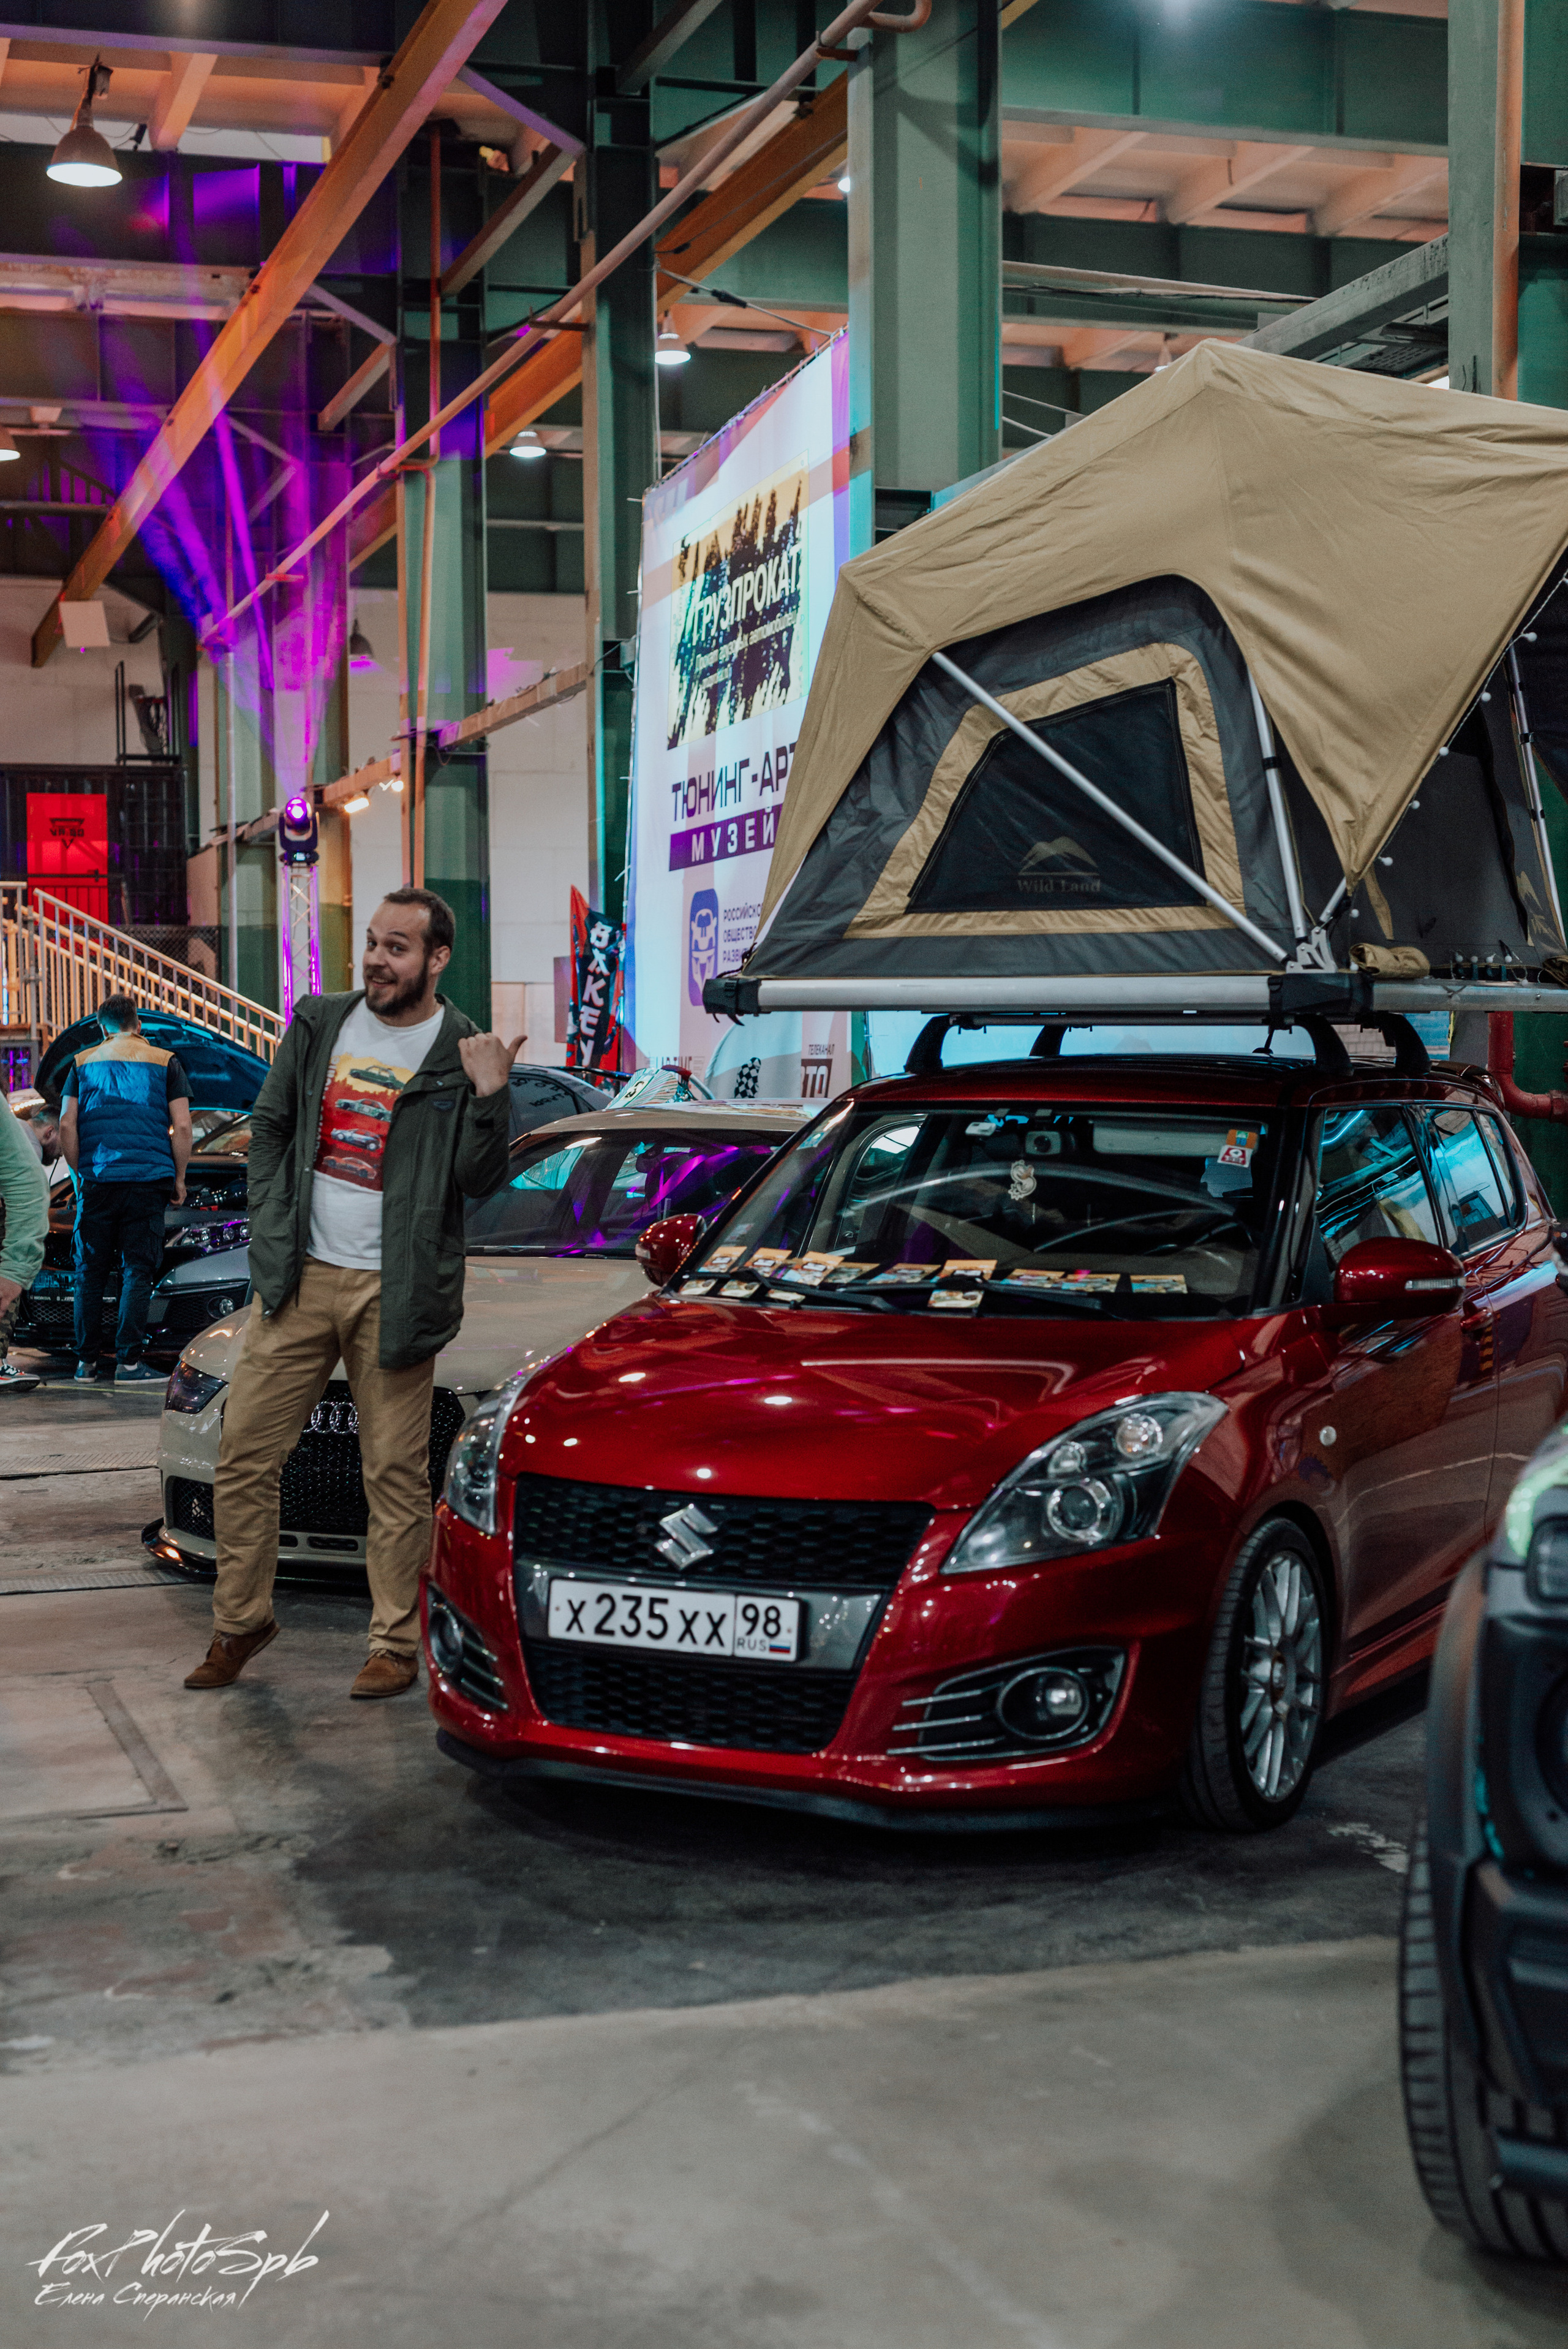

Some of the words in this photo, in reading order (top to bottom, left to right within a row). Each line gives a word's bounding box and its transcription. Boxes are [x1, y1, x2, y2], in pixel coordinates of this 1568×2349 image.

[692, 543, 802, 646] ГРУЗПРОКАТ
[692, 806, 774, 862] МУЗЕЙ
[1017, 879, 1054, 893] Wild
[1061, 879, 1101, 893] Land
[723, 902, 763, 921] РОССИЙСКО
[742, 1603, 782, 1638] 98
[737, 1638, 767, 1652] RUS
